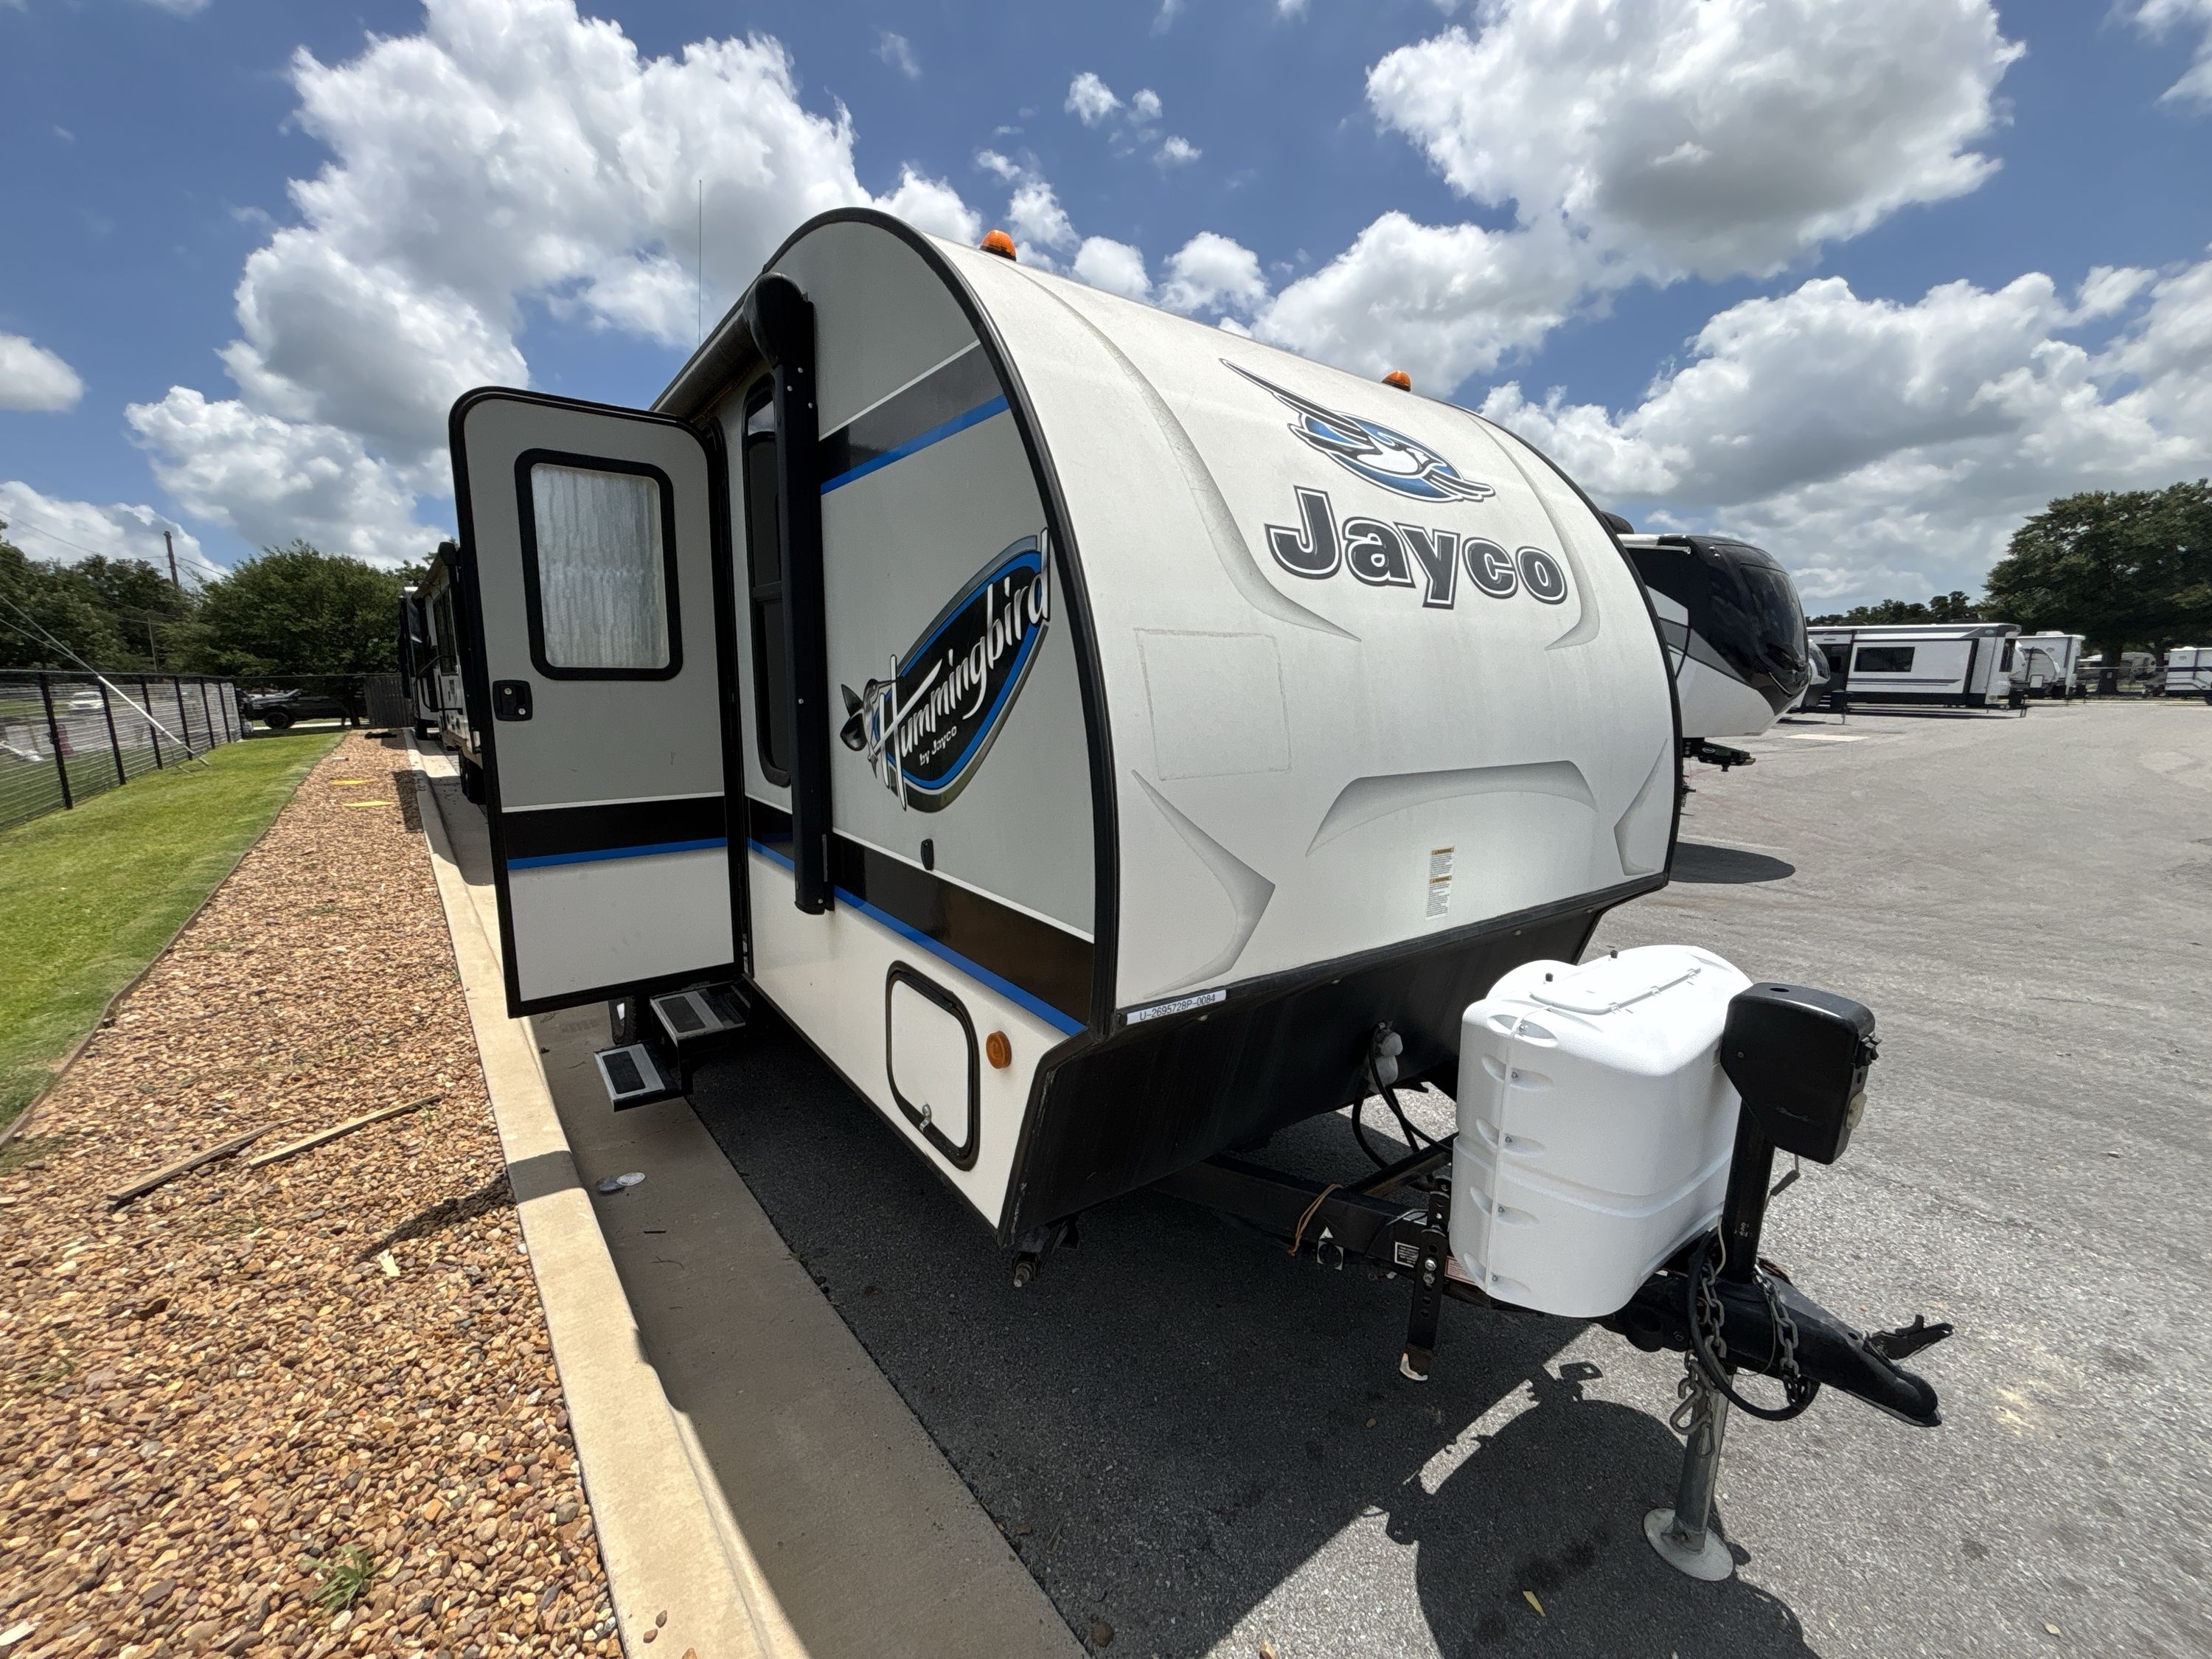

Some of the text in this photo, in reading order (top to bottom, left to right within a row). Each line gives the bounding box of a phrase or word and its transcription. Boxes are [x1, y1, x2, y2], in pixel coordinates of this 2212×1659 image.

[1264, 484, 1568, 610] Jayco
[872, 526, 1051, 812] Hummingbird
[919, 725, 957, 766] by Jayco
[1139, 993, 1216, 1021] U-2695728P-0084
